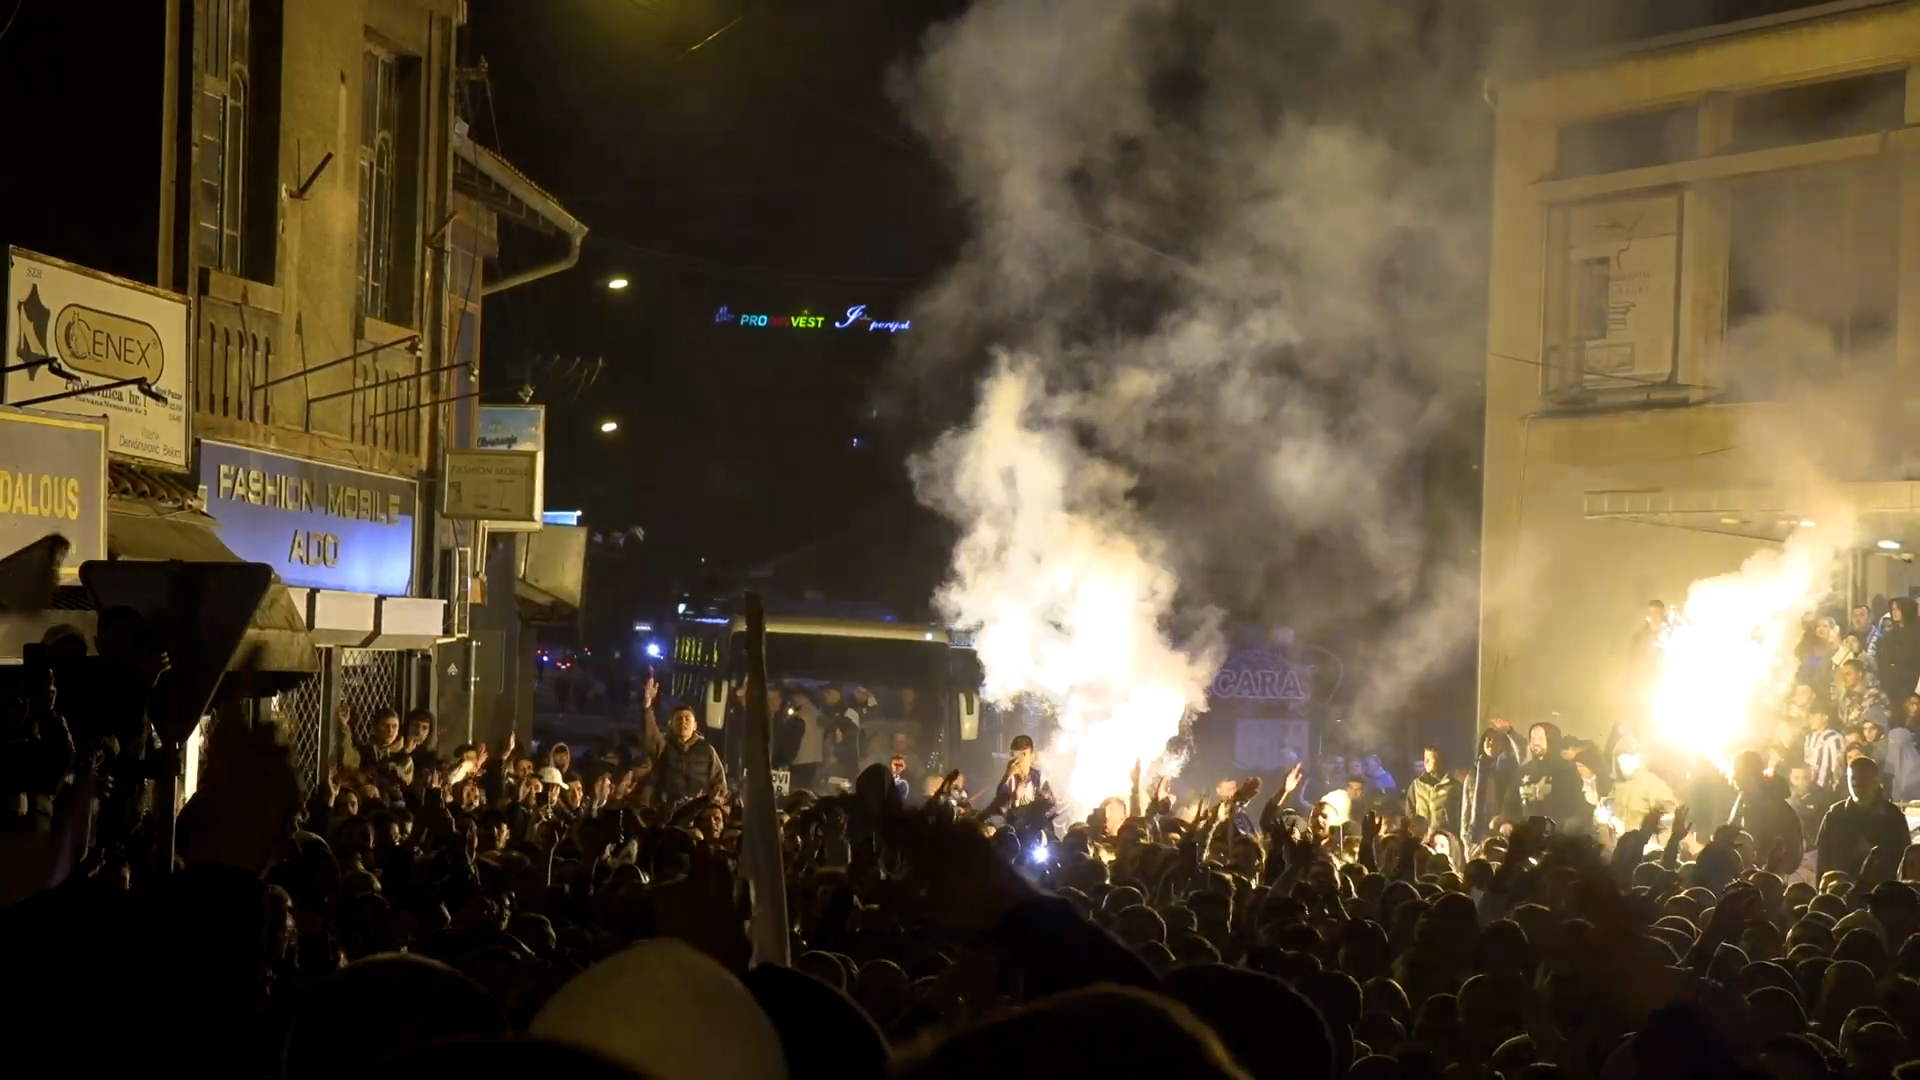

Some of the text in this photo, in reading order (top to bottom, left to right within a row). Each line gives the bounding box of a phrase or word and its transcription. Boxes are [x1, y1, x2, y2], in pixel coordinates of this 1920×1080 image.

[451, 465, 493, 475] FASHION
[218, 464, 400, 526] FASHION MOBILE
[289, 529, 340, 568] ADO
